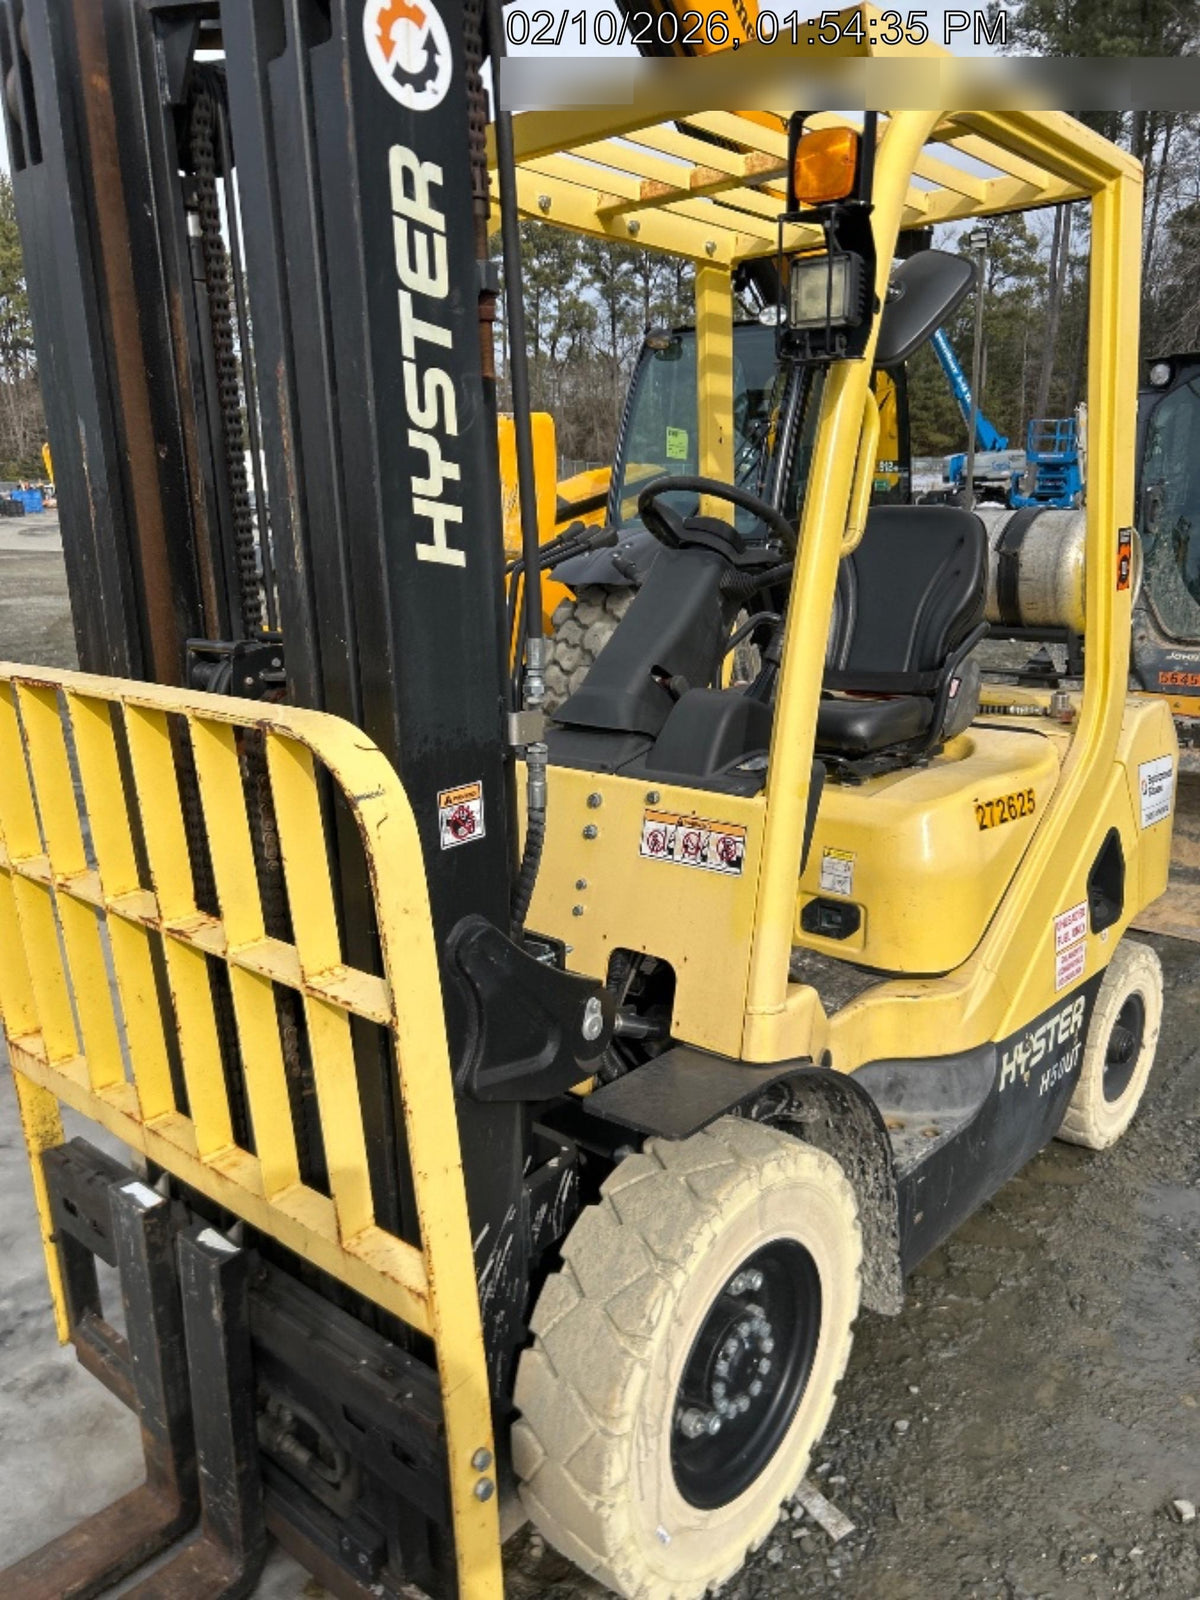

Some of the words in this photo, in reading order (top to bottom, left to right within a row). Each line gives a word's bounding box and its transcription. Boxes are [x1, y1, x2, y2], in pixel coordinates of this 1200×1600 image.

[388, 143, 467, 568] HYSTER
[975, 788, 1036, 831] 272625
[998, 994, 1086, 1092] HYSTER
